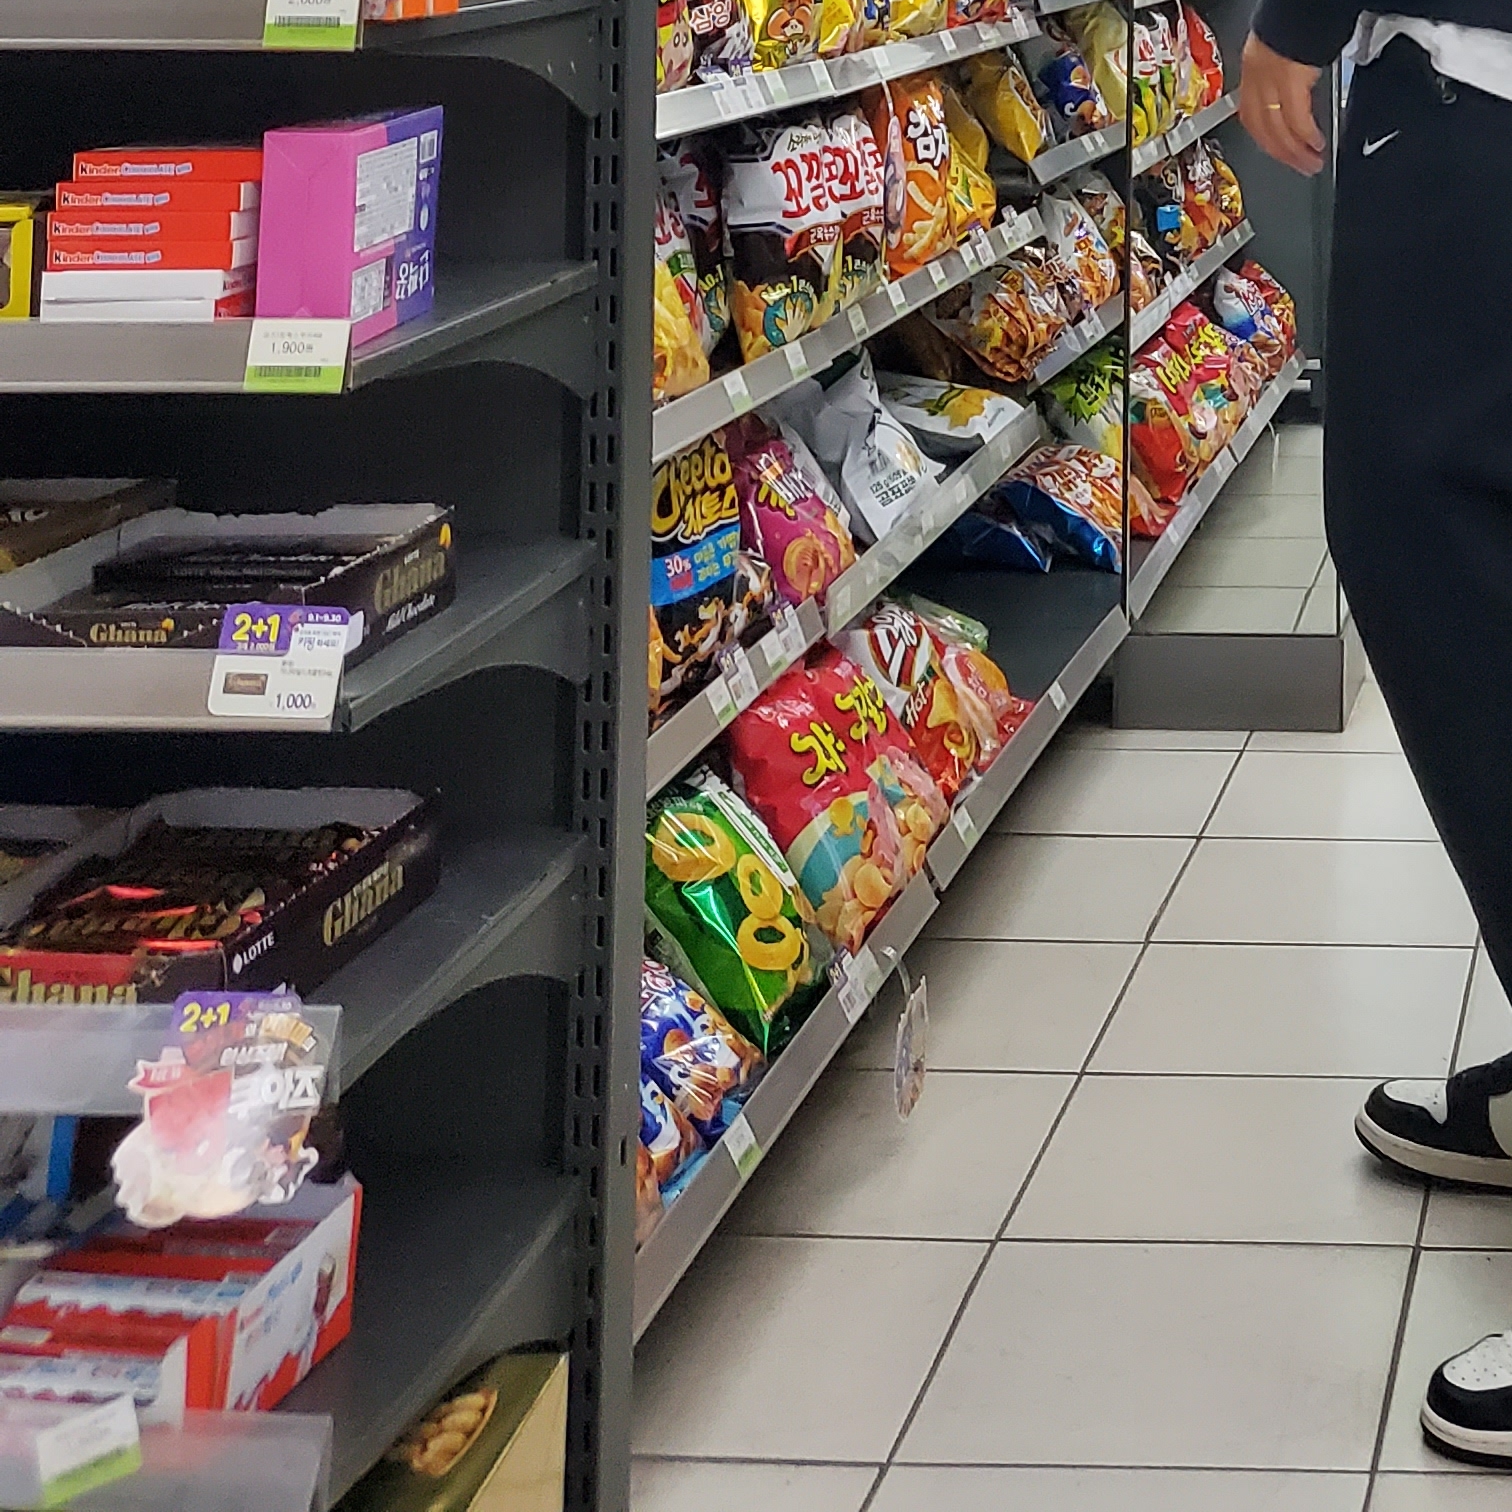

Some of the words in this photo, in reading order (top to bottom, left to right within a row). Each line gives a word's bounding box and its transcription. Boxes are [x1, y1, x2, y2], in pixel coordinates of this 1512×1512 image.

[271, 342, 313, 353] 1,900원
[652, 437, 732, 536] Cheeto
[665, 555, 692, 578] 30%
[90, 622, 168, 643] Ghana
[231, 612, 281, 641] 2+1
[276, 694, 312, 709] 1,000
[243, 932, 275, 965] LOTTE
[180, 1001, 231, 1033] 2+1
